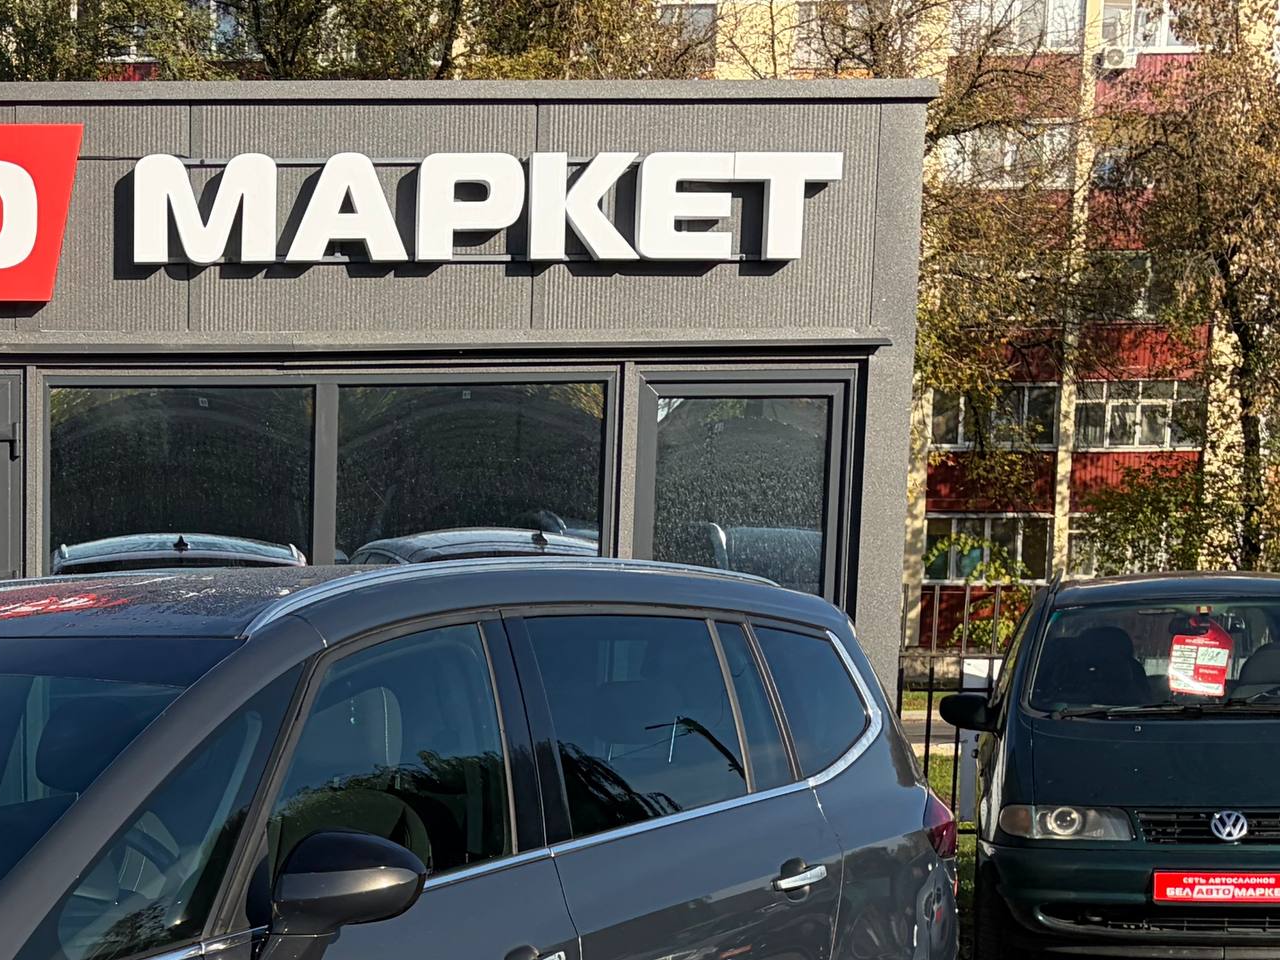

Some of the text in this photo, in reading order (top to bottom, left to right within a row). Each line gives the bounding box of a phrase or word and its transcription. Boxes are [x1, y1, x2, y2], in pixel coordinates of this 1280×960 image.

[133, 151, 844, 264] МАРКЕТ
[1208, 877, 1276, 885] АВТОСАЛОНОВ
[1166, 887, 1192, 897] БЕЛ
[1196, 887, 1232, 897] АВТО
